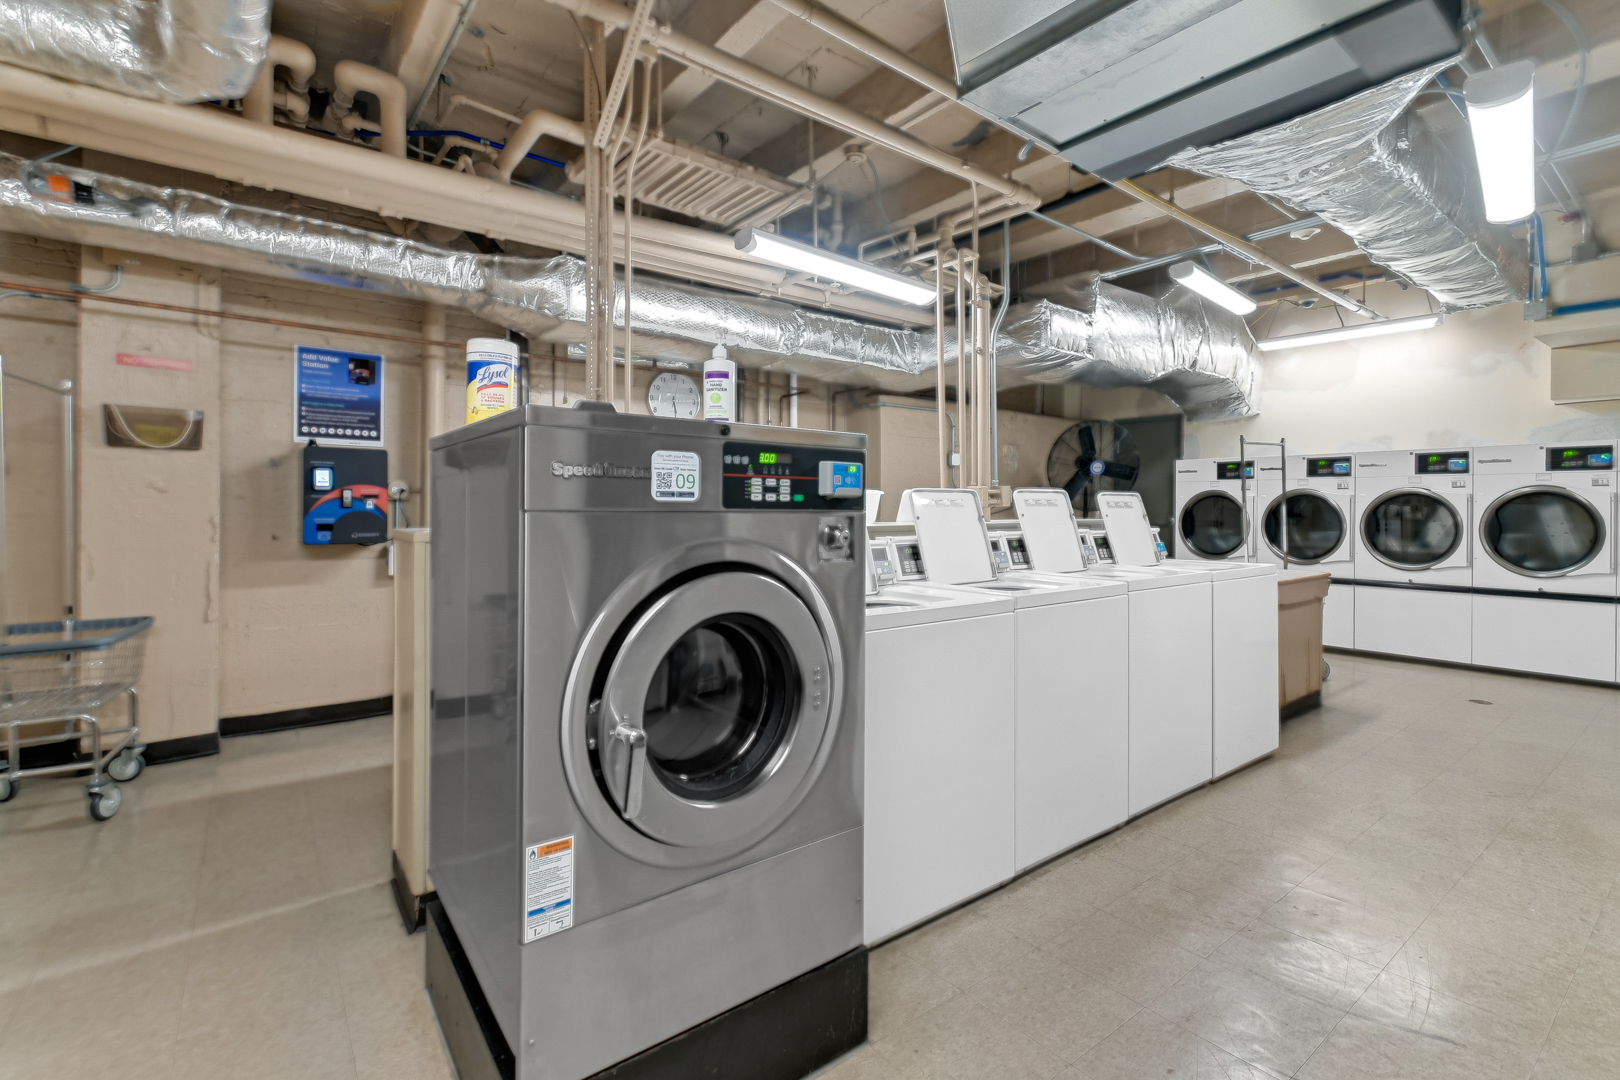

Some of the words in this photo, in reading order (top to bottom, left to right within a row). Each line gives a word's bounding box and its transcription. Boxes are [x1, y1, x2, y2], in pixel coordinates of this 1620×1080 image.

[123, 356, 138, 364] NO
[302, 353, 317, 361] Add
[318, 355, 339, 363] Value
[302, 361, 329, 369] Station
[478, 366, 509, 384] Lysol
[676, 473, 696, 490] 09
